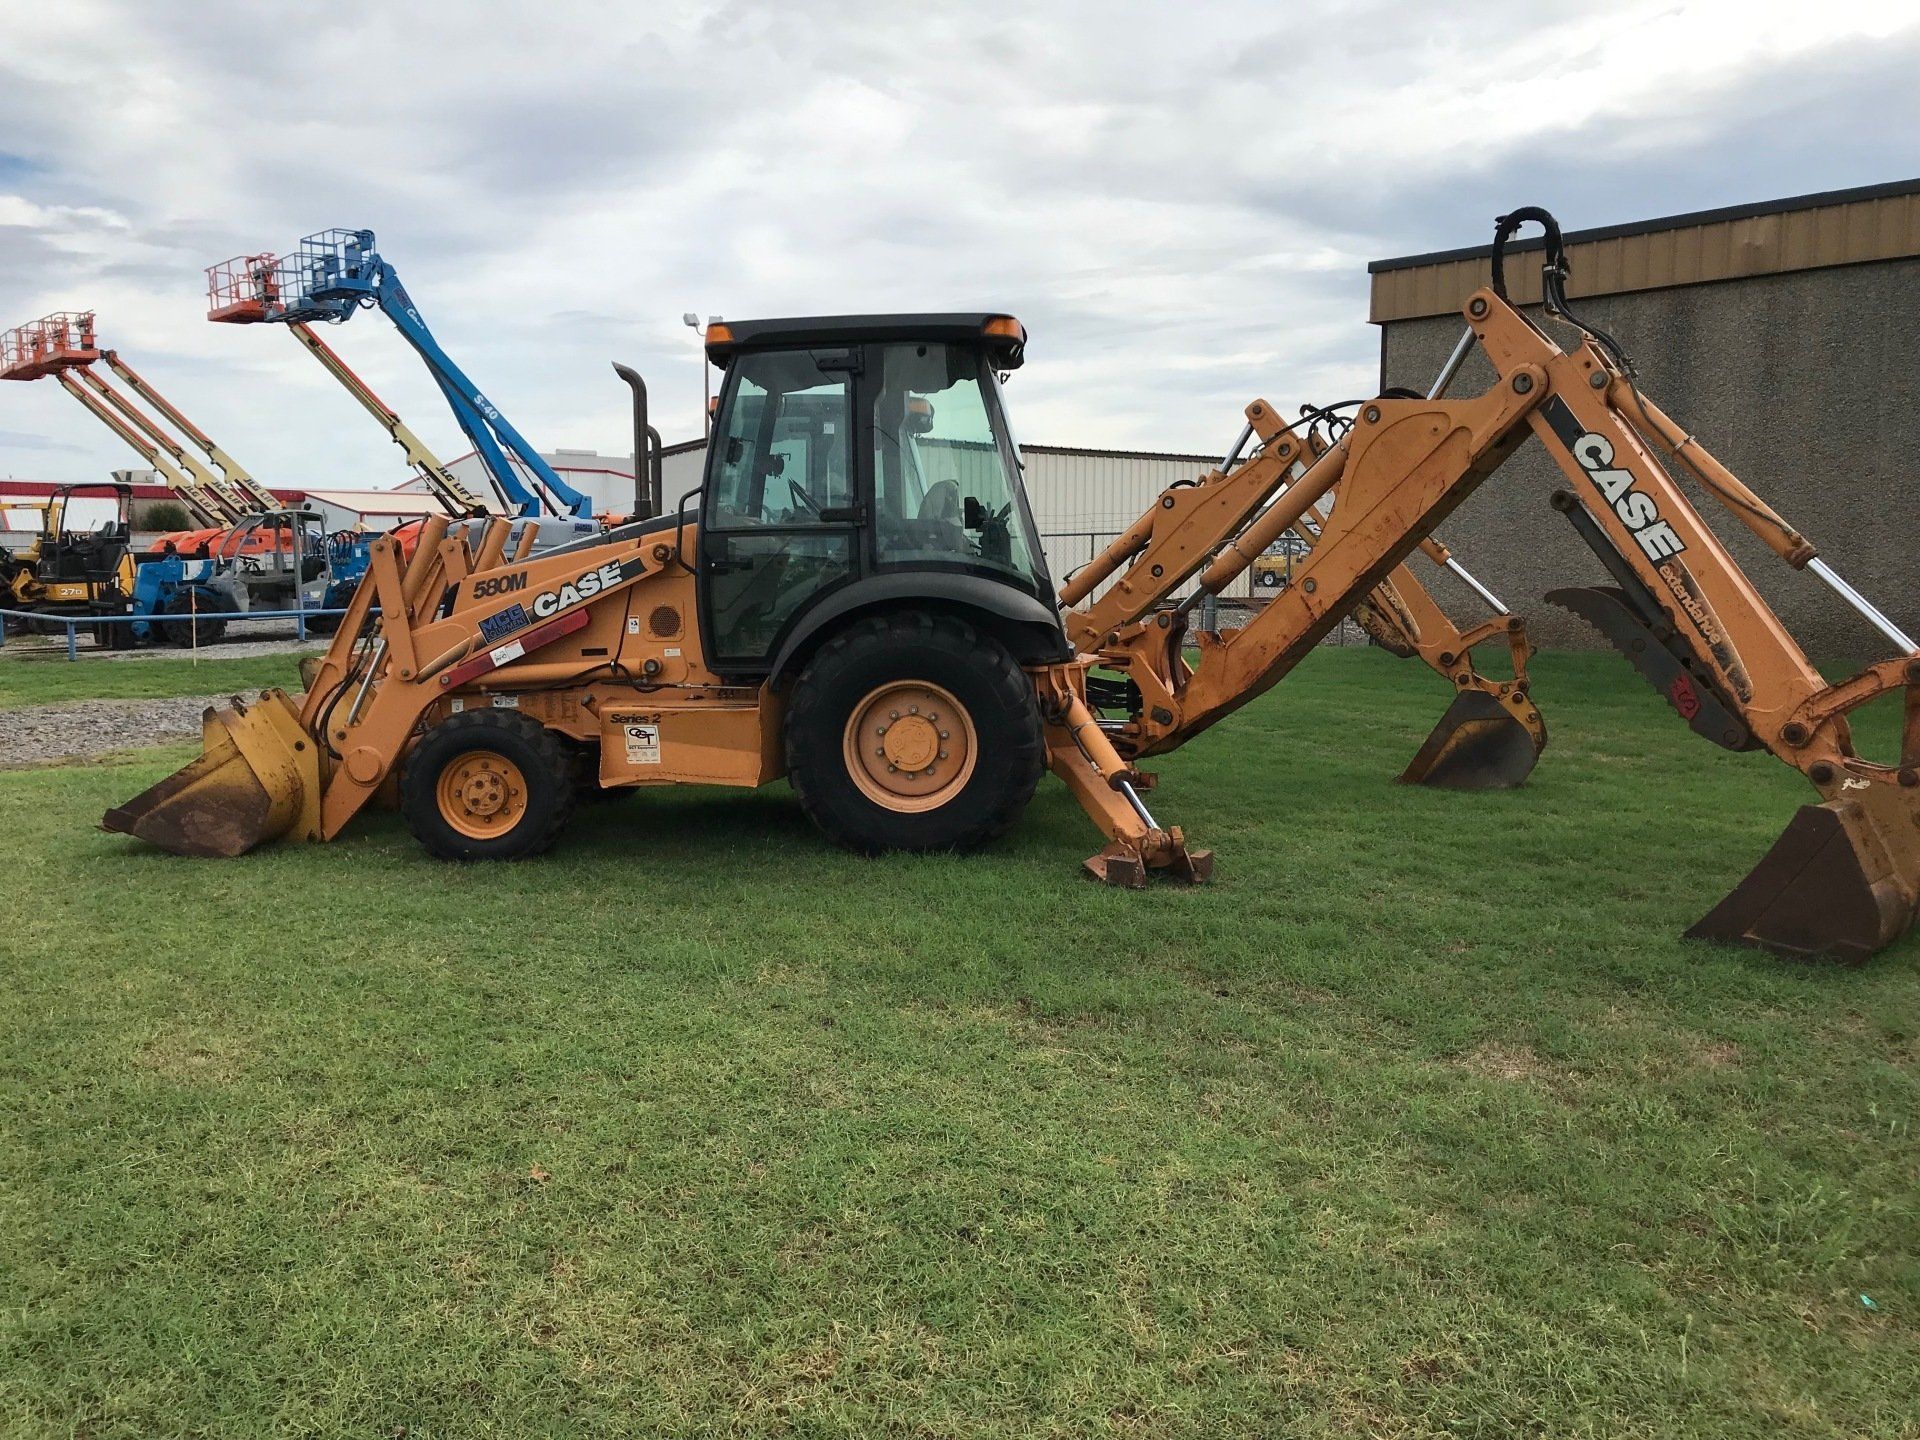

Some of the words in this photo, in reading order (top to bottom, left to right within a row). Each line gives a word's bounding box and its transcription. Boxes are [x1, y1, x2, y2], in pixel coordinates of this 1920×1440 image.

[474, 394, 498, 420] S-40
[211, 480, 228, 494] JLG
[243, 478, 261, 492] JLG
[259, 491, 280, 508] LIFT
[436, 466, 455, 482] JLG
[452, 482, 475, 501] LIFT
[1574, 432, 1687, 562] CASE
[183, 484, 200, 498] JLG
[198, 497, 218, 513] LIFT
[473, 571, 527, 599] 580M
[533, 560, 623, 617] CASE
[480, 603, 523, 631] MCG
[1660, 564, 1721, 645] extendahoe
[486, 616, 527, 640] EQUIPMENT
[610, 713, 649, 724] Series
[652, 713, 661, 724] 2
